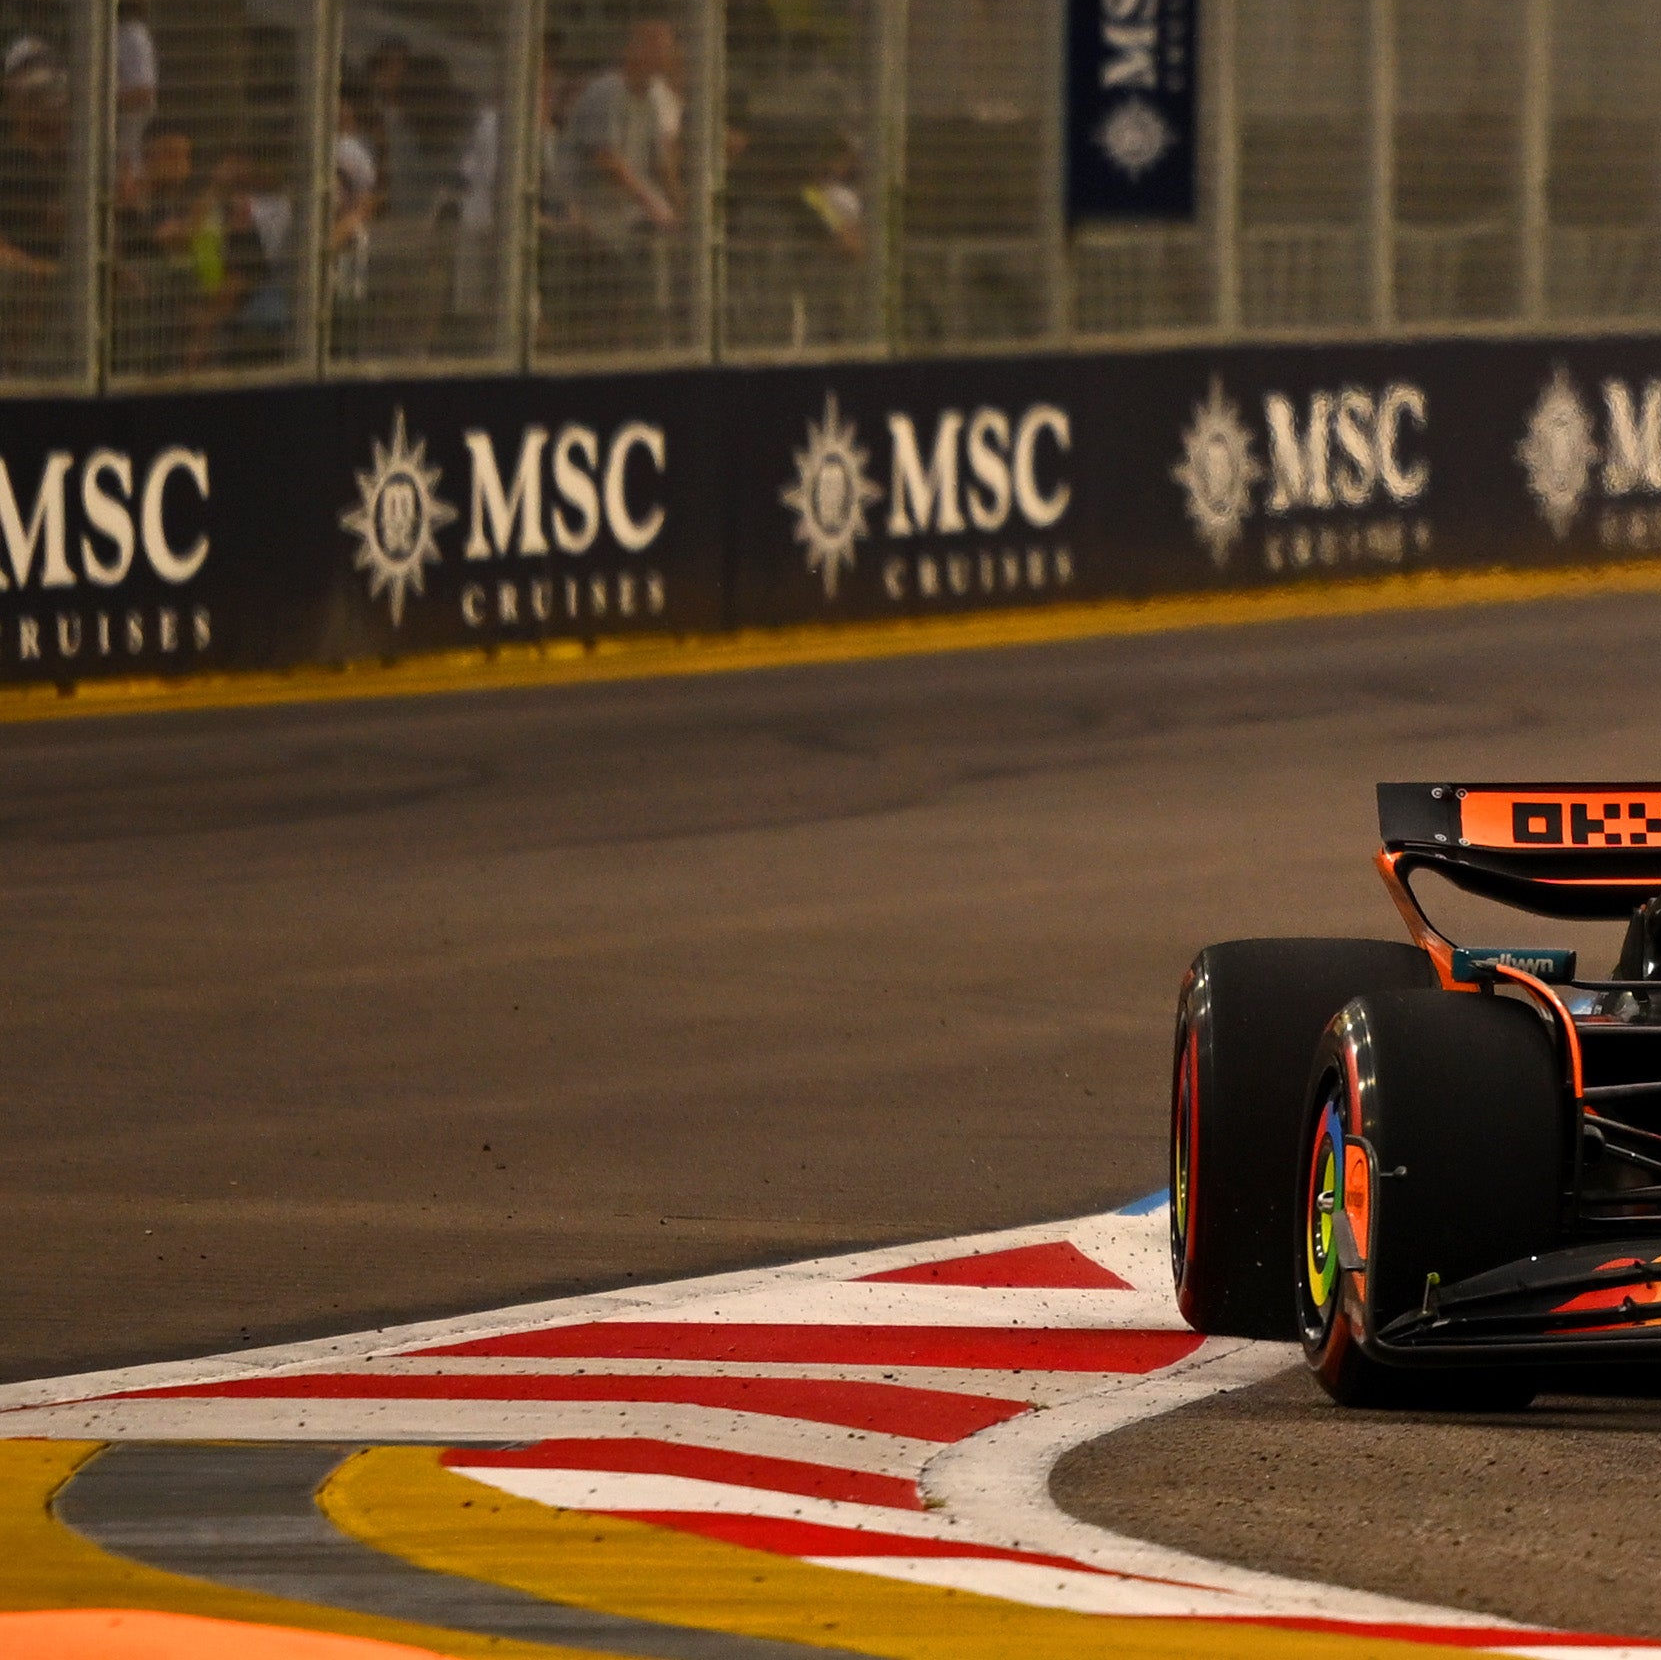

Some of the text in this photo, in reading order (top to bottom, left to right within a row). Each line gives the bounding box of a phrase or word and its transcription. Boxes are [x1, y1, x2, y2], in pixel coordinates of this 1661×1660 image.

[464, 423, 666, 560] MSC
[888, 403, 1072, 538] MSC
[1265, 382, 1427, 514] MSC
[0, 444, 210, 588] MSC
[0, 606, 211, 660] RUISES
[461, 572, 666, 628] CRUISES
